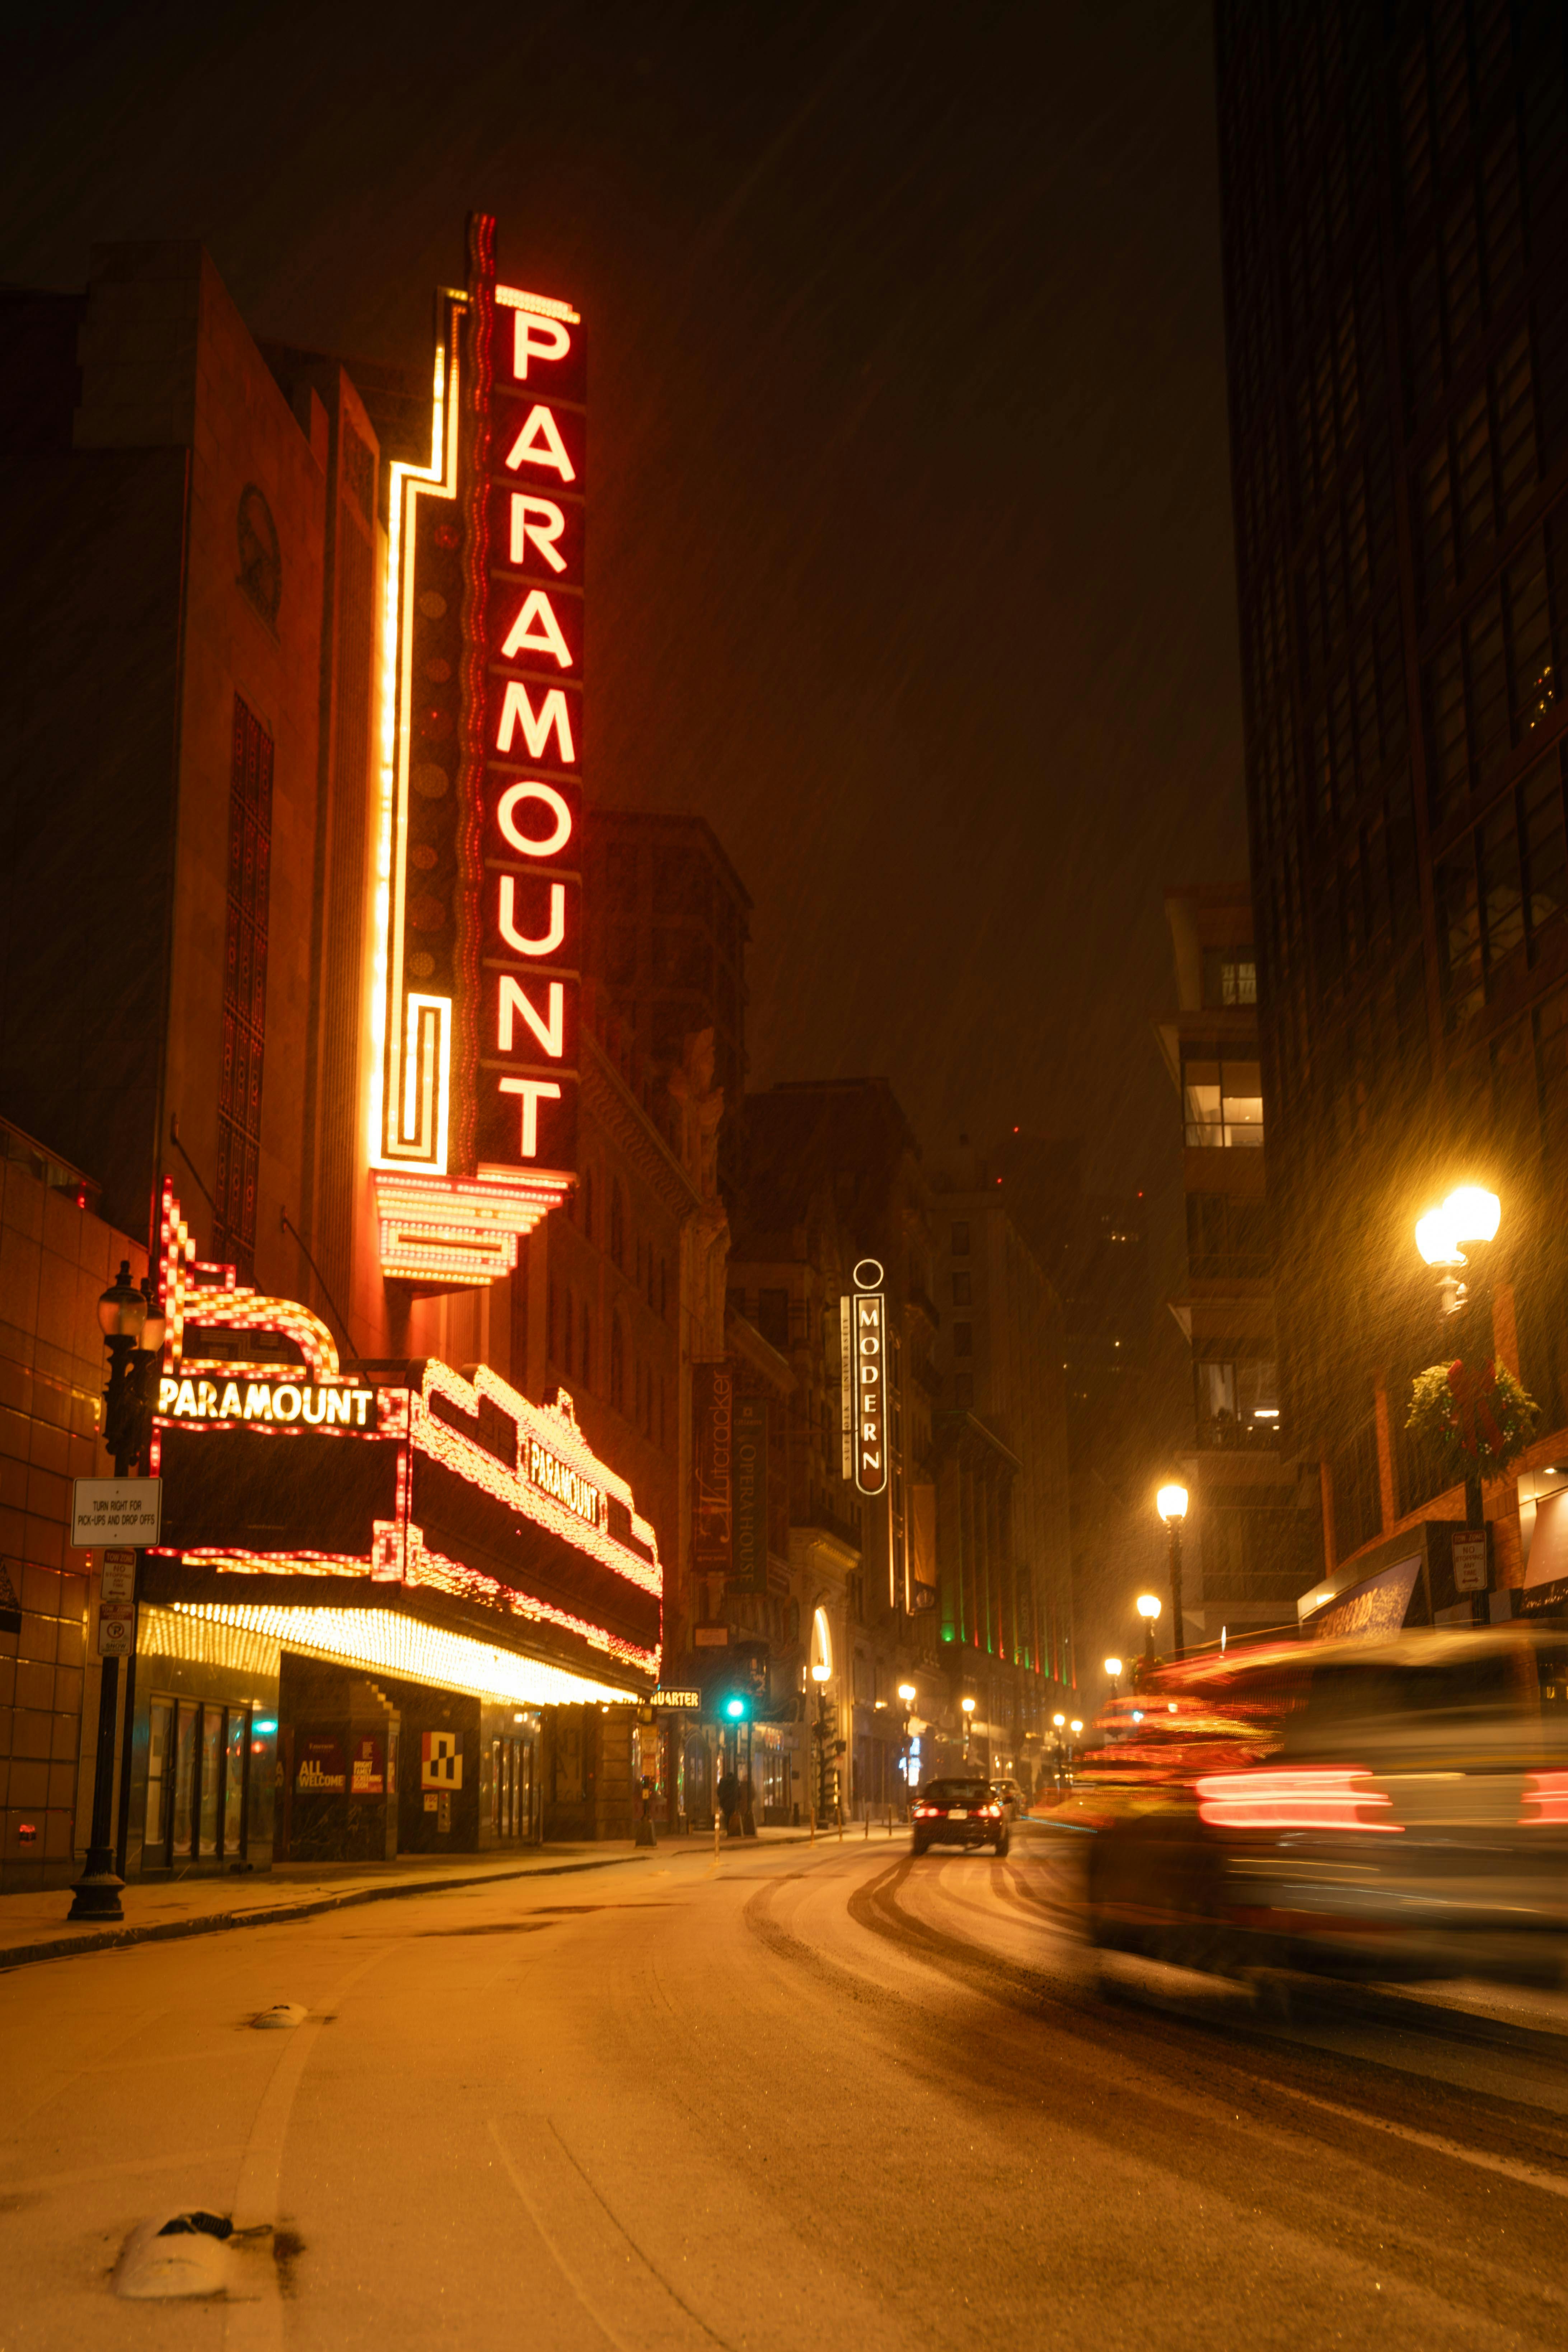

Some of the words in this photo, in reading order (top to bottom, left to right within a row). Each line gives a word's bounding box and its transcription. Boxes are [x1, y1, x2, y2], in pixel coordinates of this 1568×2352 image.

[496, 309, 576, 1158] PARAMOUNT
[158, 1378, 373, 1425] PARAMOUNT
[860, 1309, 880, 1470] MODERN
[696, 1370, 730, 1542] Nutcracker
[531, 1442, 597, 1524] PARAMOUNT
[739, 1444, 757, 1514] OPERA
[78, 1515, 106, 1525] PICK-UPS
[108, 1515, 120, 1525] AND
[122, 1514, 138, 1525] DROP
[140, 1514, 155, 1525] OFFS
[93, 1500, 108, 1511] TURN
[111, 1500, 128, 1511] RIGHT
[130, 1500, 142, 1511] FOR
[107, 1553, 119, 1561] TOW
[121, 1553, 133, 1562] ZONE
[1463, 1546, 1475, 1554] NO
[299, 1760, 323, 1776] ALL
[299, 1775, 344, 1788] WELCOME
